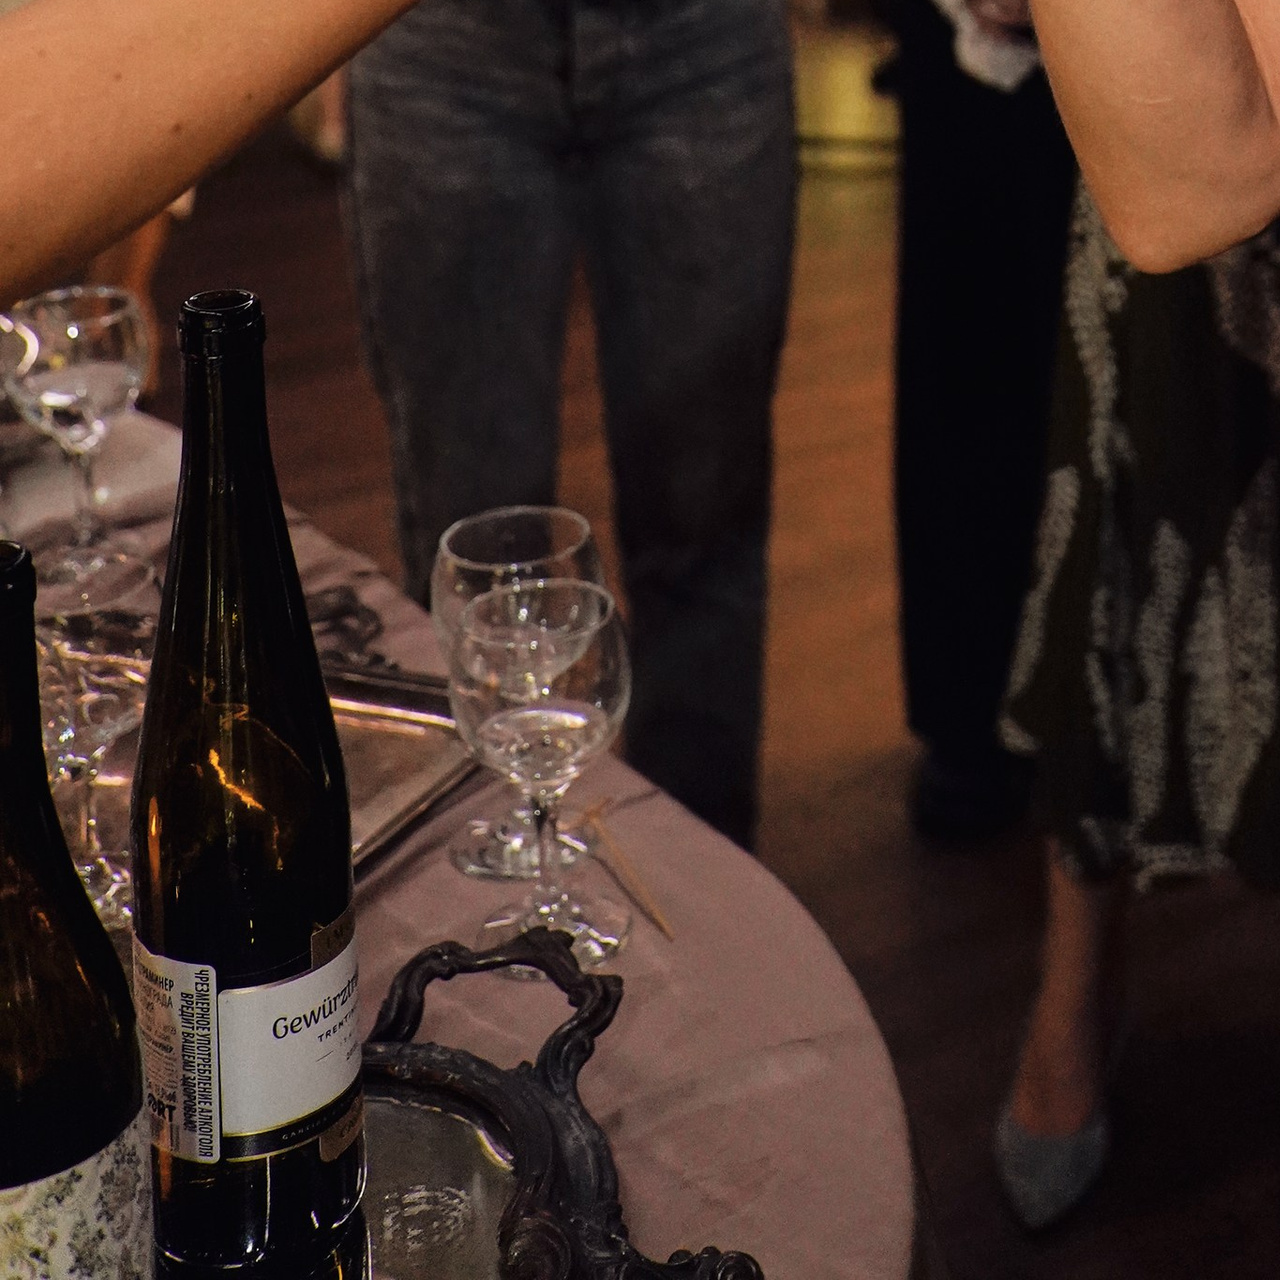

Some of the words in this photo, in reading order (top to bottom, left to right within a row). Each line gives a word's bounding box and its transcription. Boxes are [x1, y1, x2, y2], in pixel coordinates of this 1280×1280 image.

[179, 992, 195, 1031] ВРЕДИТ
[194, 969, 211, 1032] ЧРЕЗМЕРНОЕ
[182, 1031, 197, 1074] ВАШЕМУ
[196, 1032, 213, 1106] УПОТРЕБЛЕНИЕ
[198, 1107, 213, 1157] АЛКОГОЛЯ
